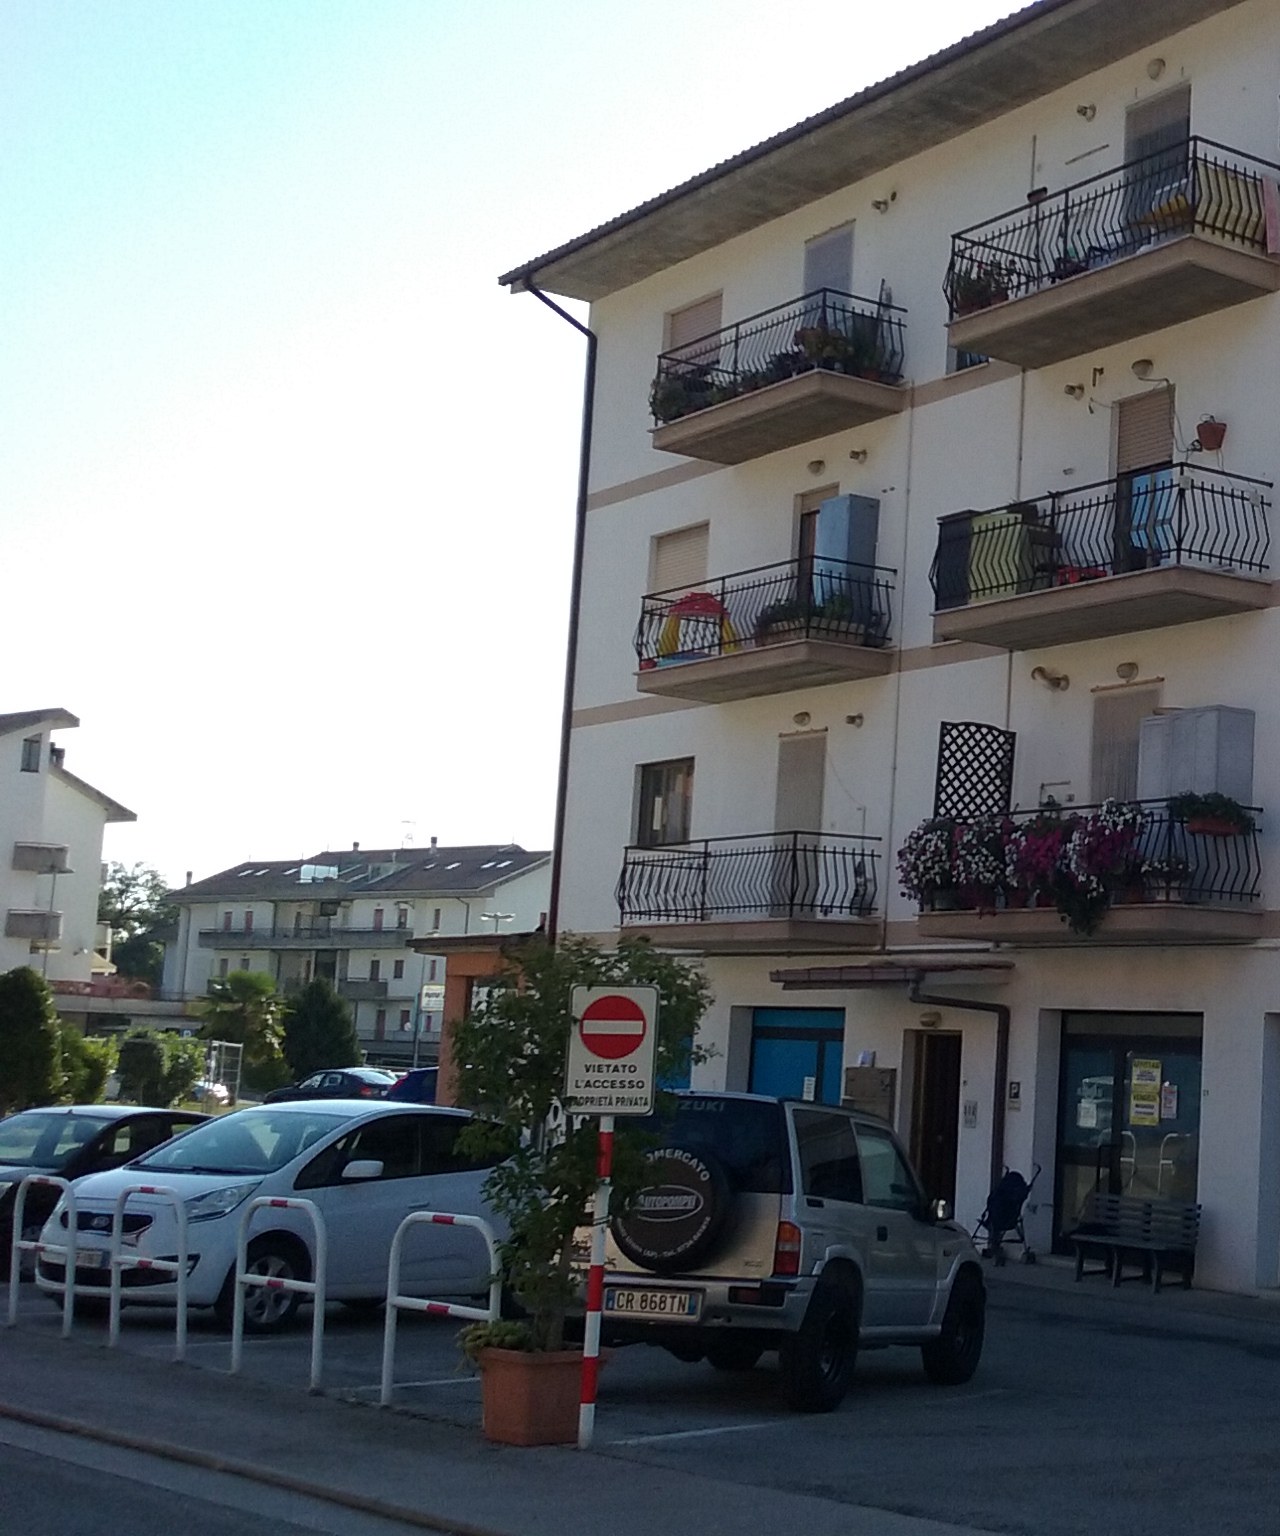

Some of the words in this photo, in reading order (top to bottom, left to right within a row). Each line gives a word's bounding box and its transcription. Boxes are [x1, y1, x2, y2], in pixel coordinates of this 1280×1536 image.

[584, 1064, 637, 1074] VIETATO
[575, 1080, 645, 1089] L'ACCESSO
[615, 1096, 649, 1107] PRIVATA
[616, 1292, 635, 1309] CR
[639, 1293, 687, 1313] 868TN
